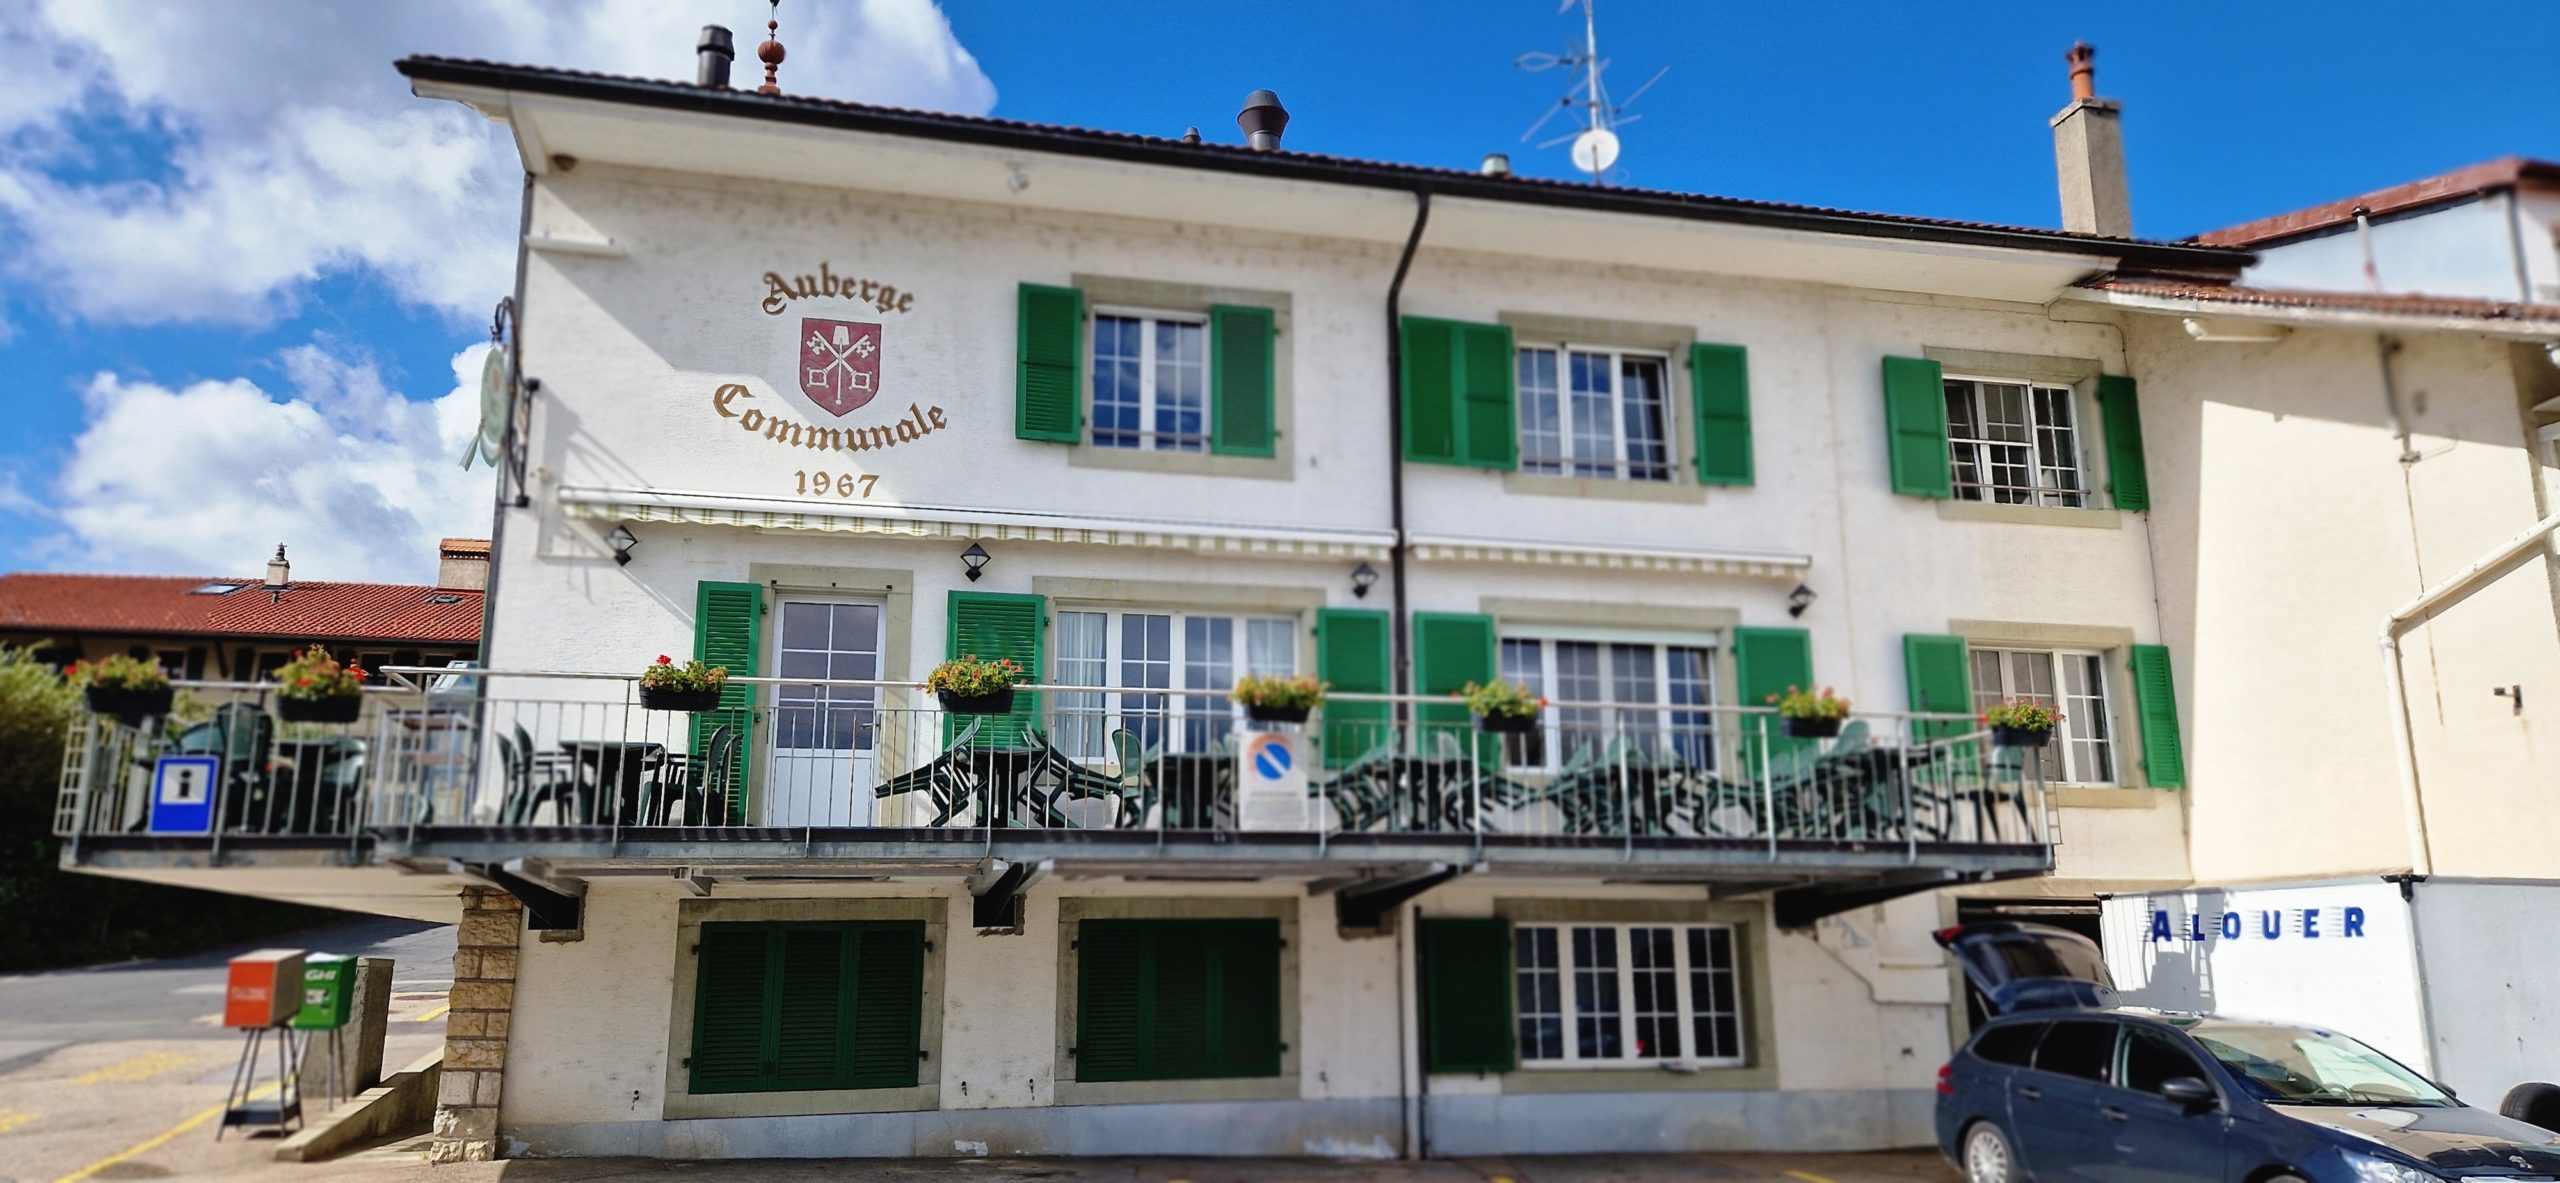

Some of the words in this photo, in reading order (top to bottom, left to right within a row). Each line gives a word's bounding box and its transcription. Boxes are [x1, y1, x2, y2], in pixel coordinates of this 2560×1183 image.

[762, 261, 915, 316] Auberge
[713, 383, 948, 452] Communale
[794, 469, 880, 499] 1967
